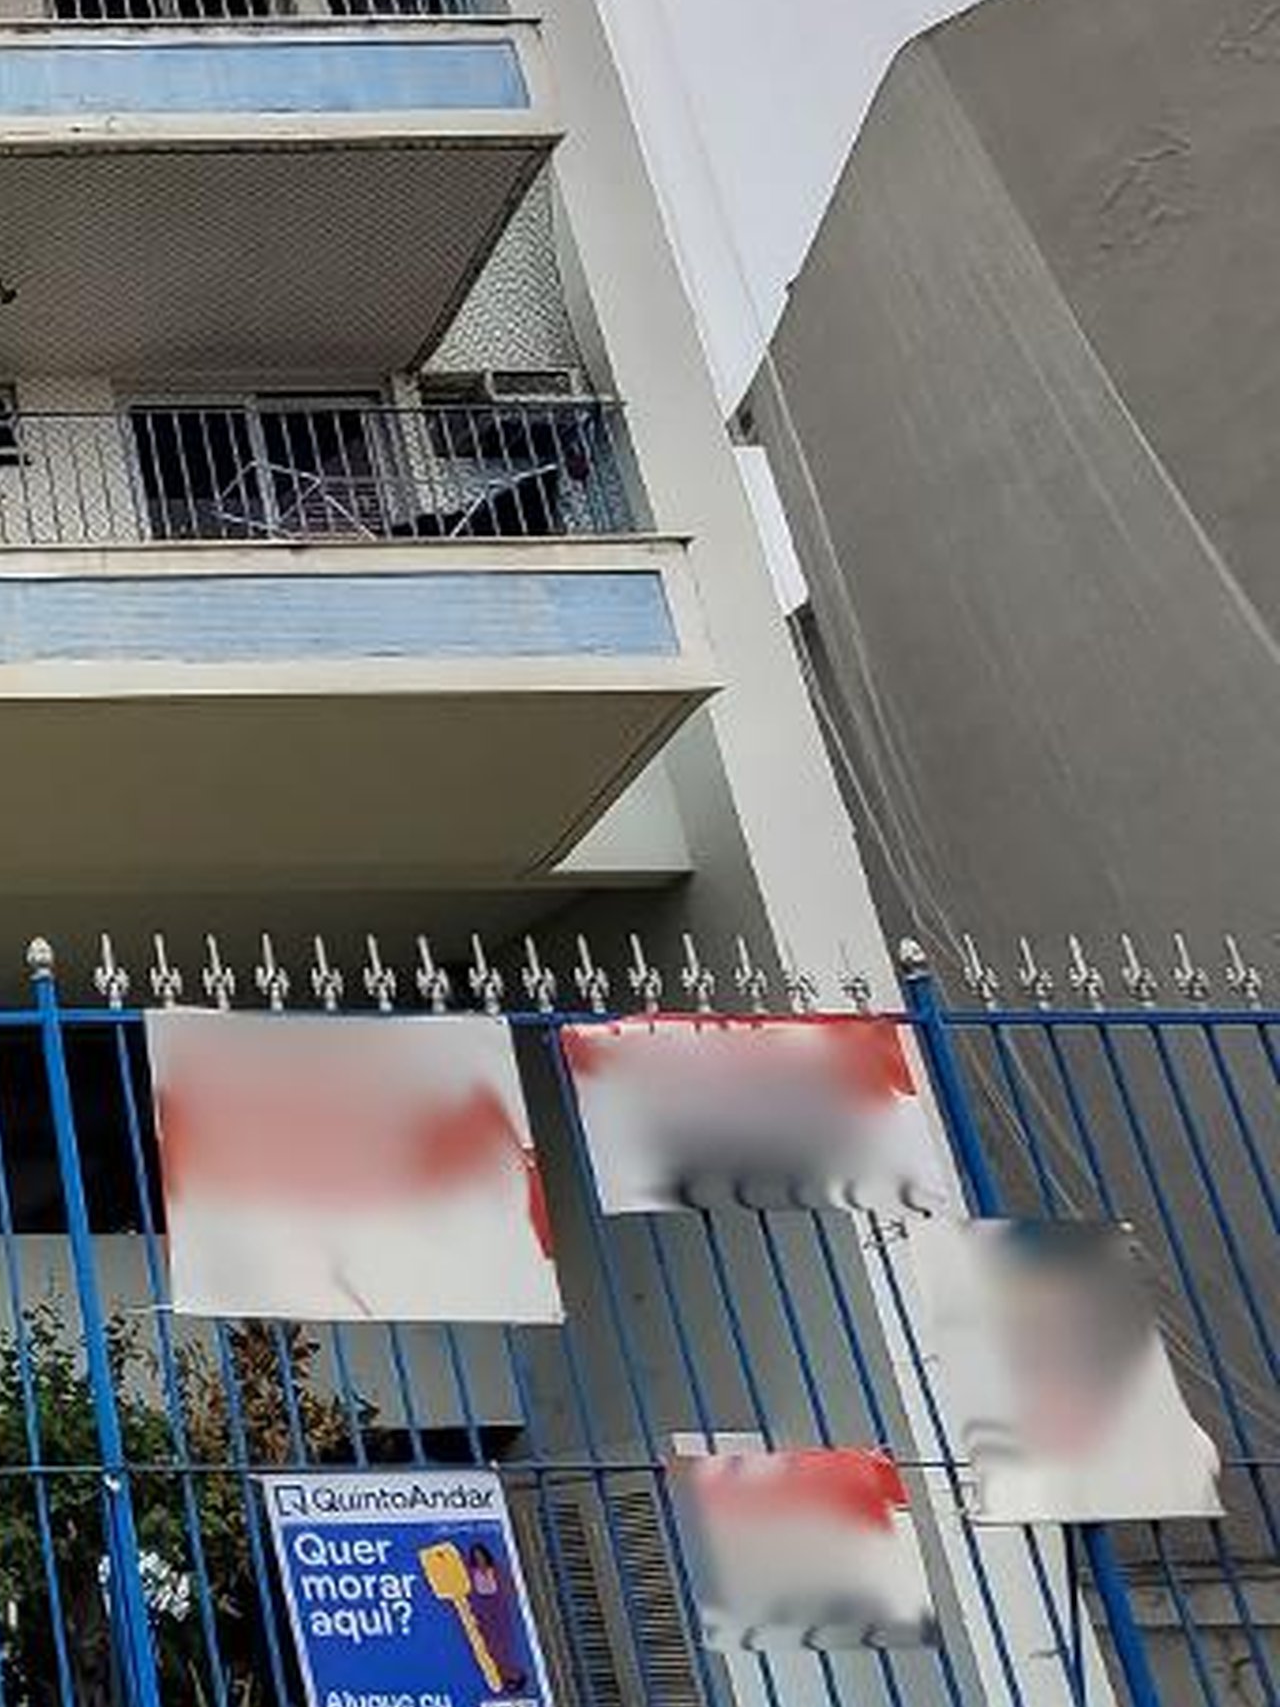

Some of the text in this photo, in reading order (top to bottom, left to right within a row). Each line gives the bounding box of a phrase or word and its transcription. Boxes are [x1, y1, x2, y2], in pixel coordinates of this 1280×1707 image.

[312, 1485, 494, 1513] QuintoAndar
[293, 1532, 392, 1566] Quer
[300, 1572, 416, 1600] morar
[310, 1600, 412, 1643] aqui?
